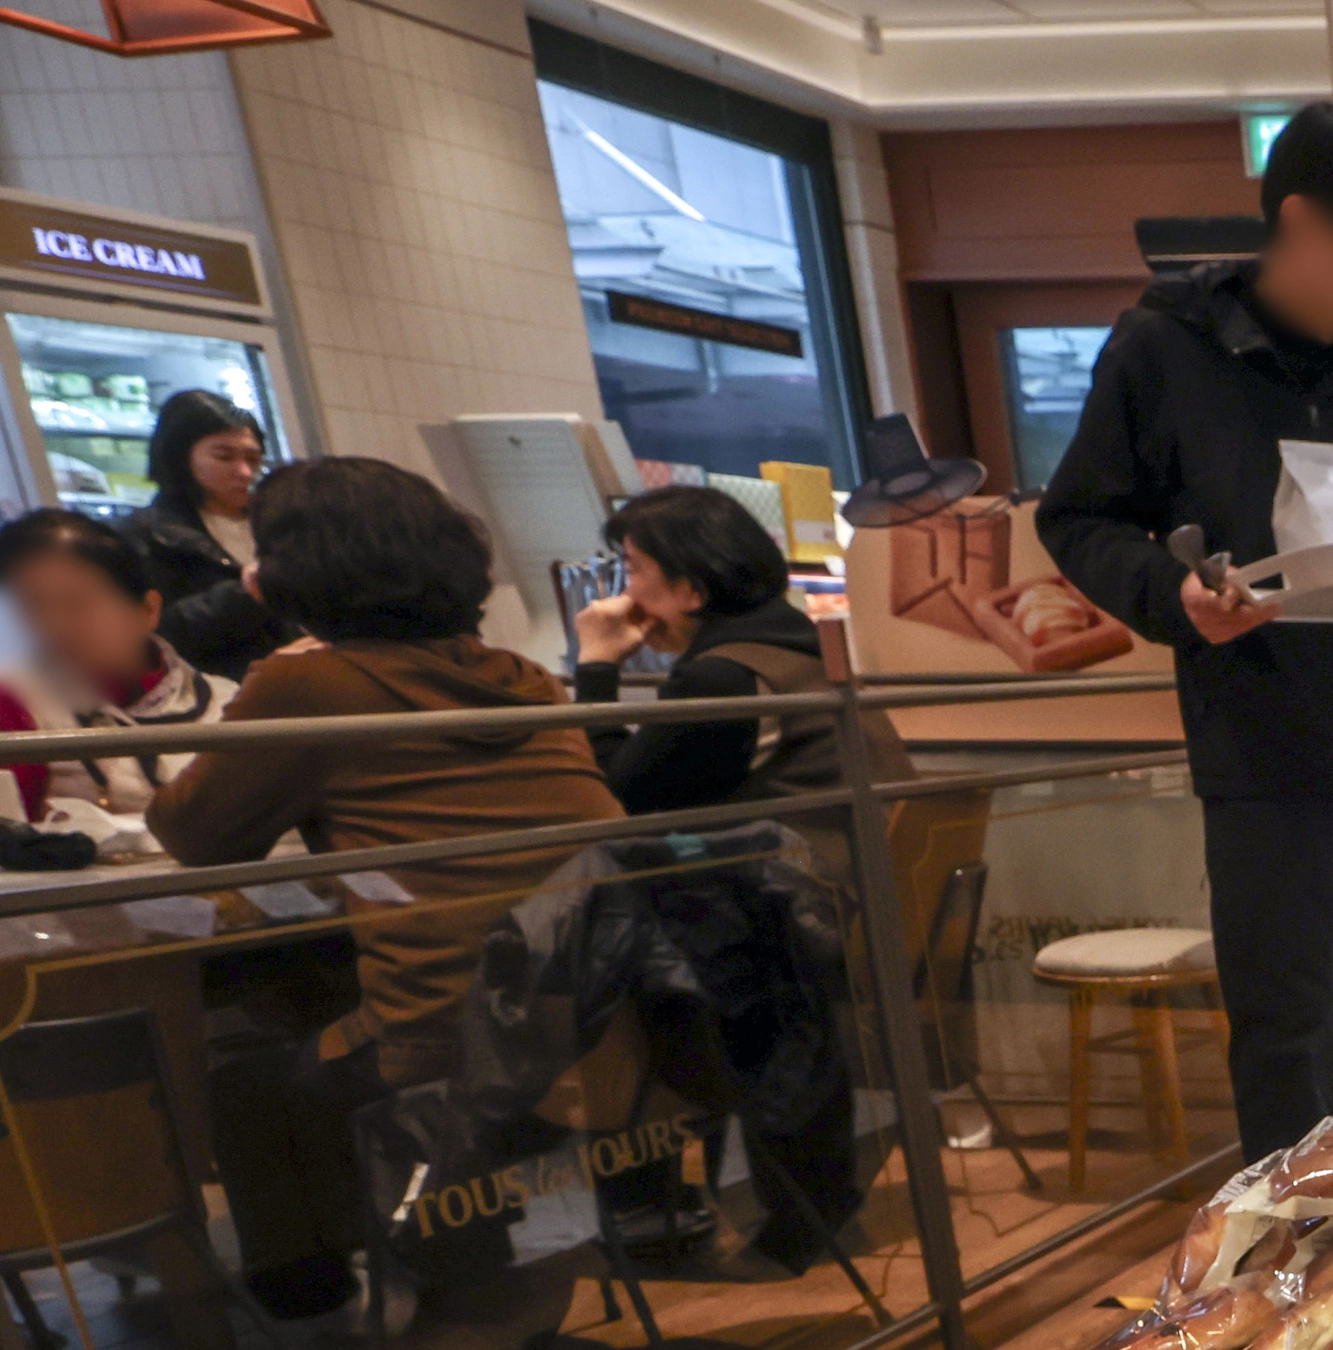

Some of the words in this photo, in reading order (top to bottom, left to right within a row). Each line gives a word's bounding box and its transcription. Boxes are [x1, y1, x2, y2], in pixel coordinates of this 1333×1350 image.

[32, 227, 93, 262] ICE
[92, 238, 206, 280] CREAM
[412, 1165, 531, 1238] TOUS
[578, 1112, 697, 1191] JOURS
